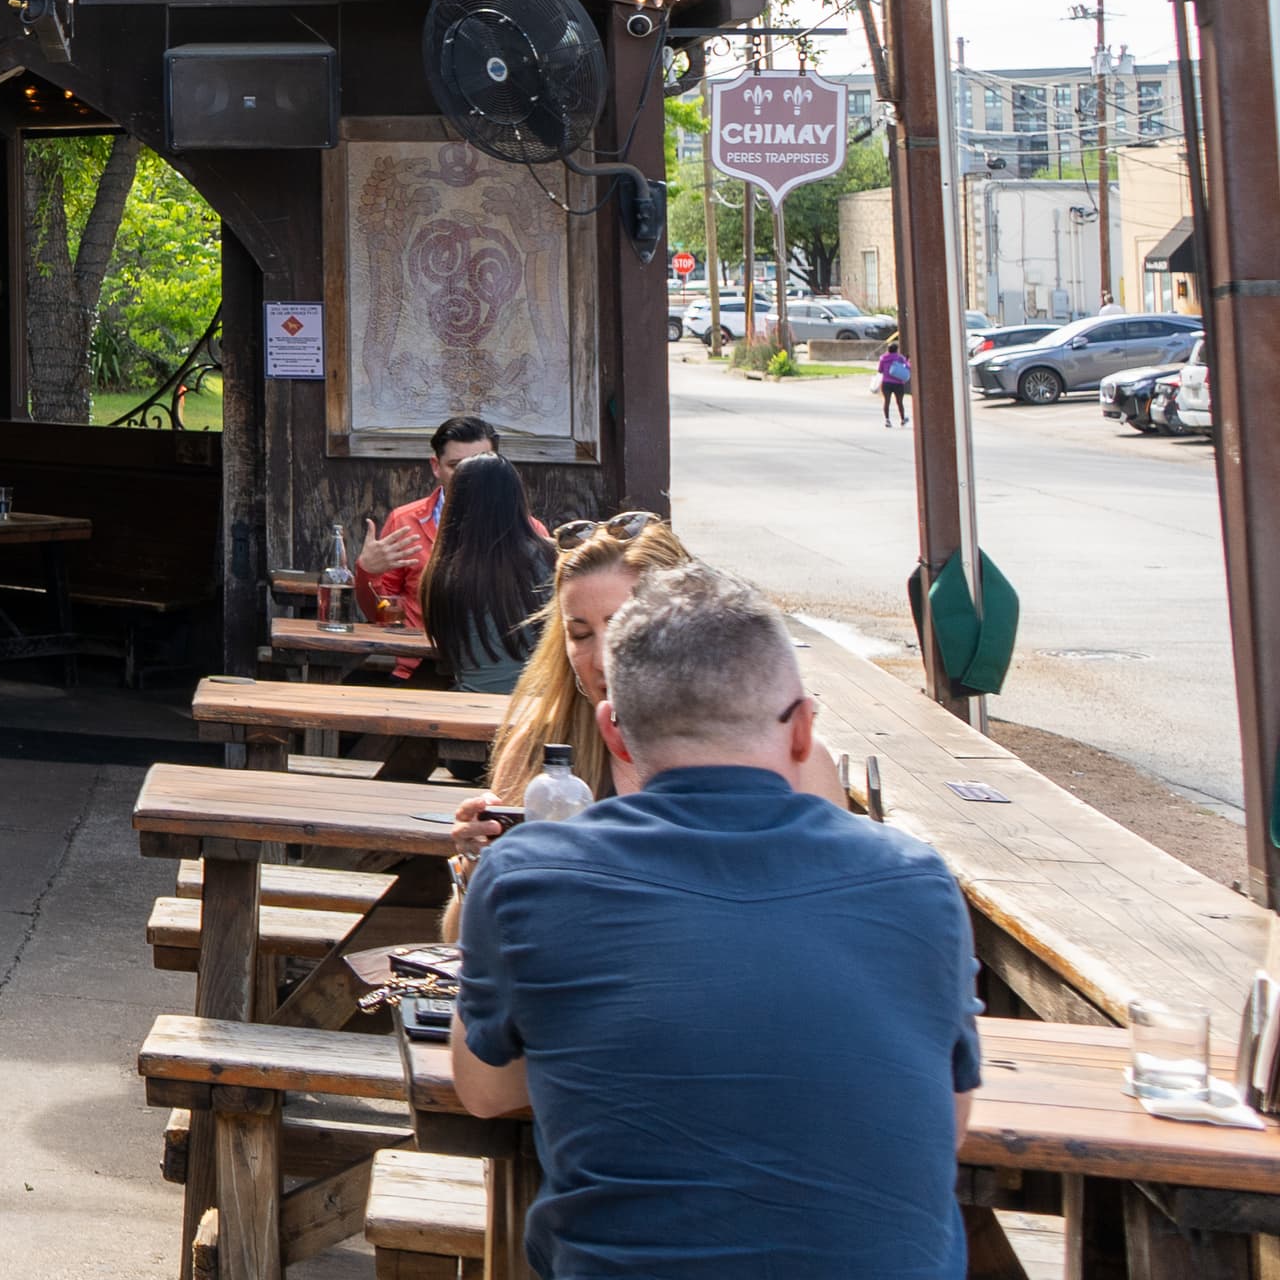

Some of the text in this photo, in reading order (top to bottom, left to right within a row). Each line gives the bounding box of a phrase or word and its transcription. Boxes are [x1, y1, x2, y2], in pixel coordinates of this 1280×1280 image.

[721, 123, 836, 144] CHIMAY
[726, 152, 829, 164] PERES TRAPPISTES
[673, 258, 693, 269] STOP
